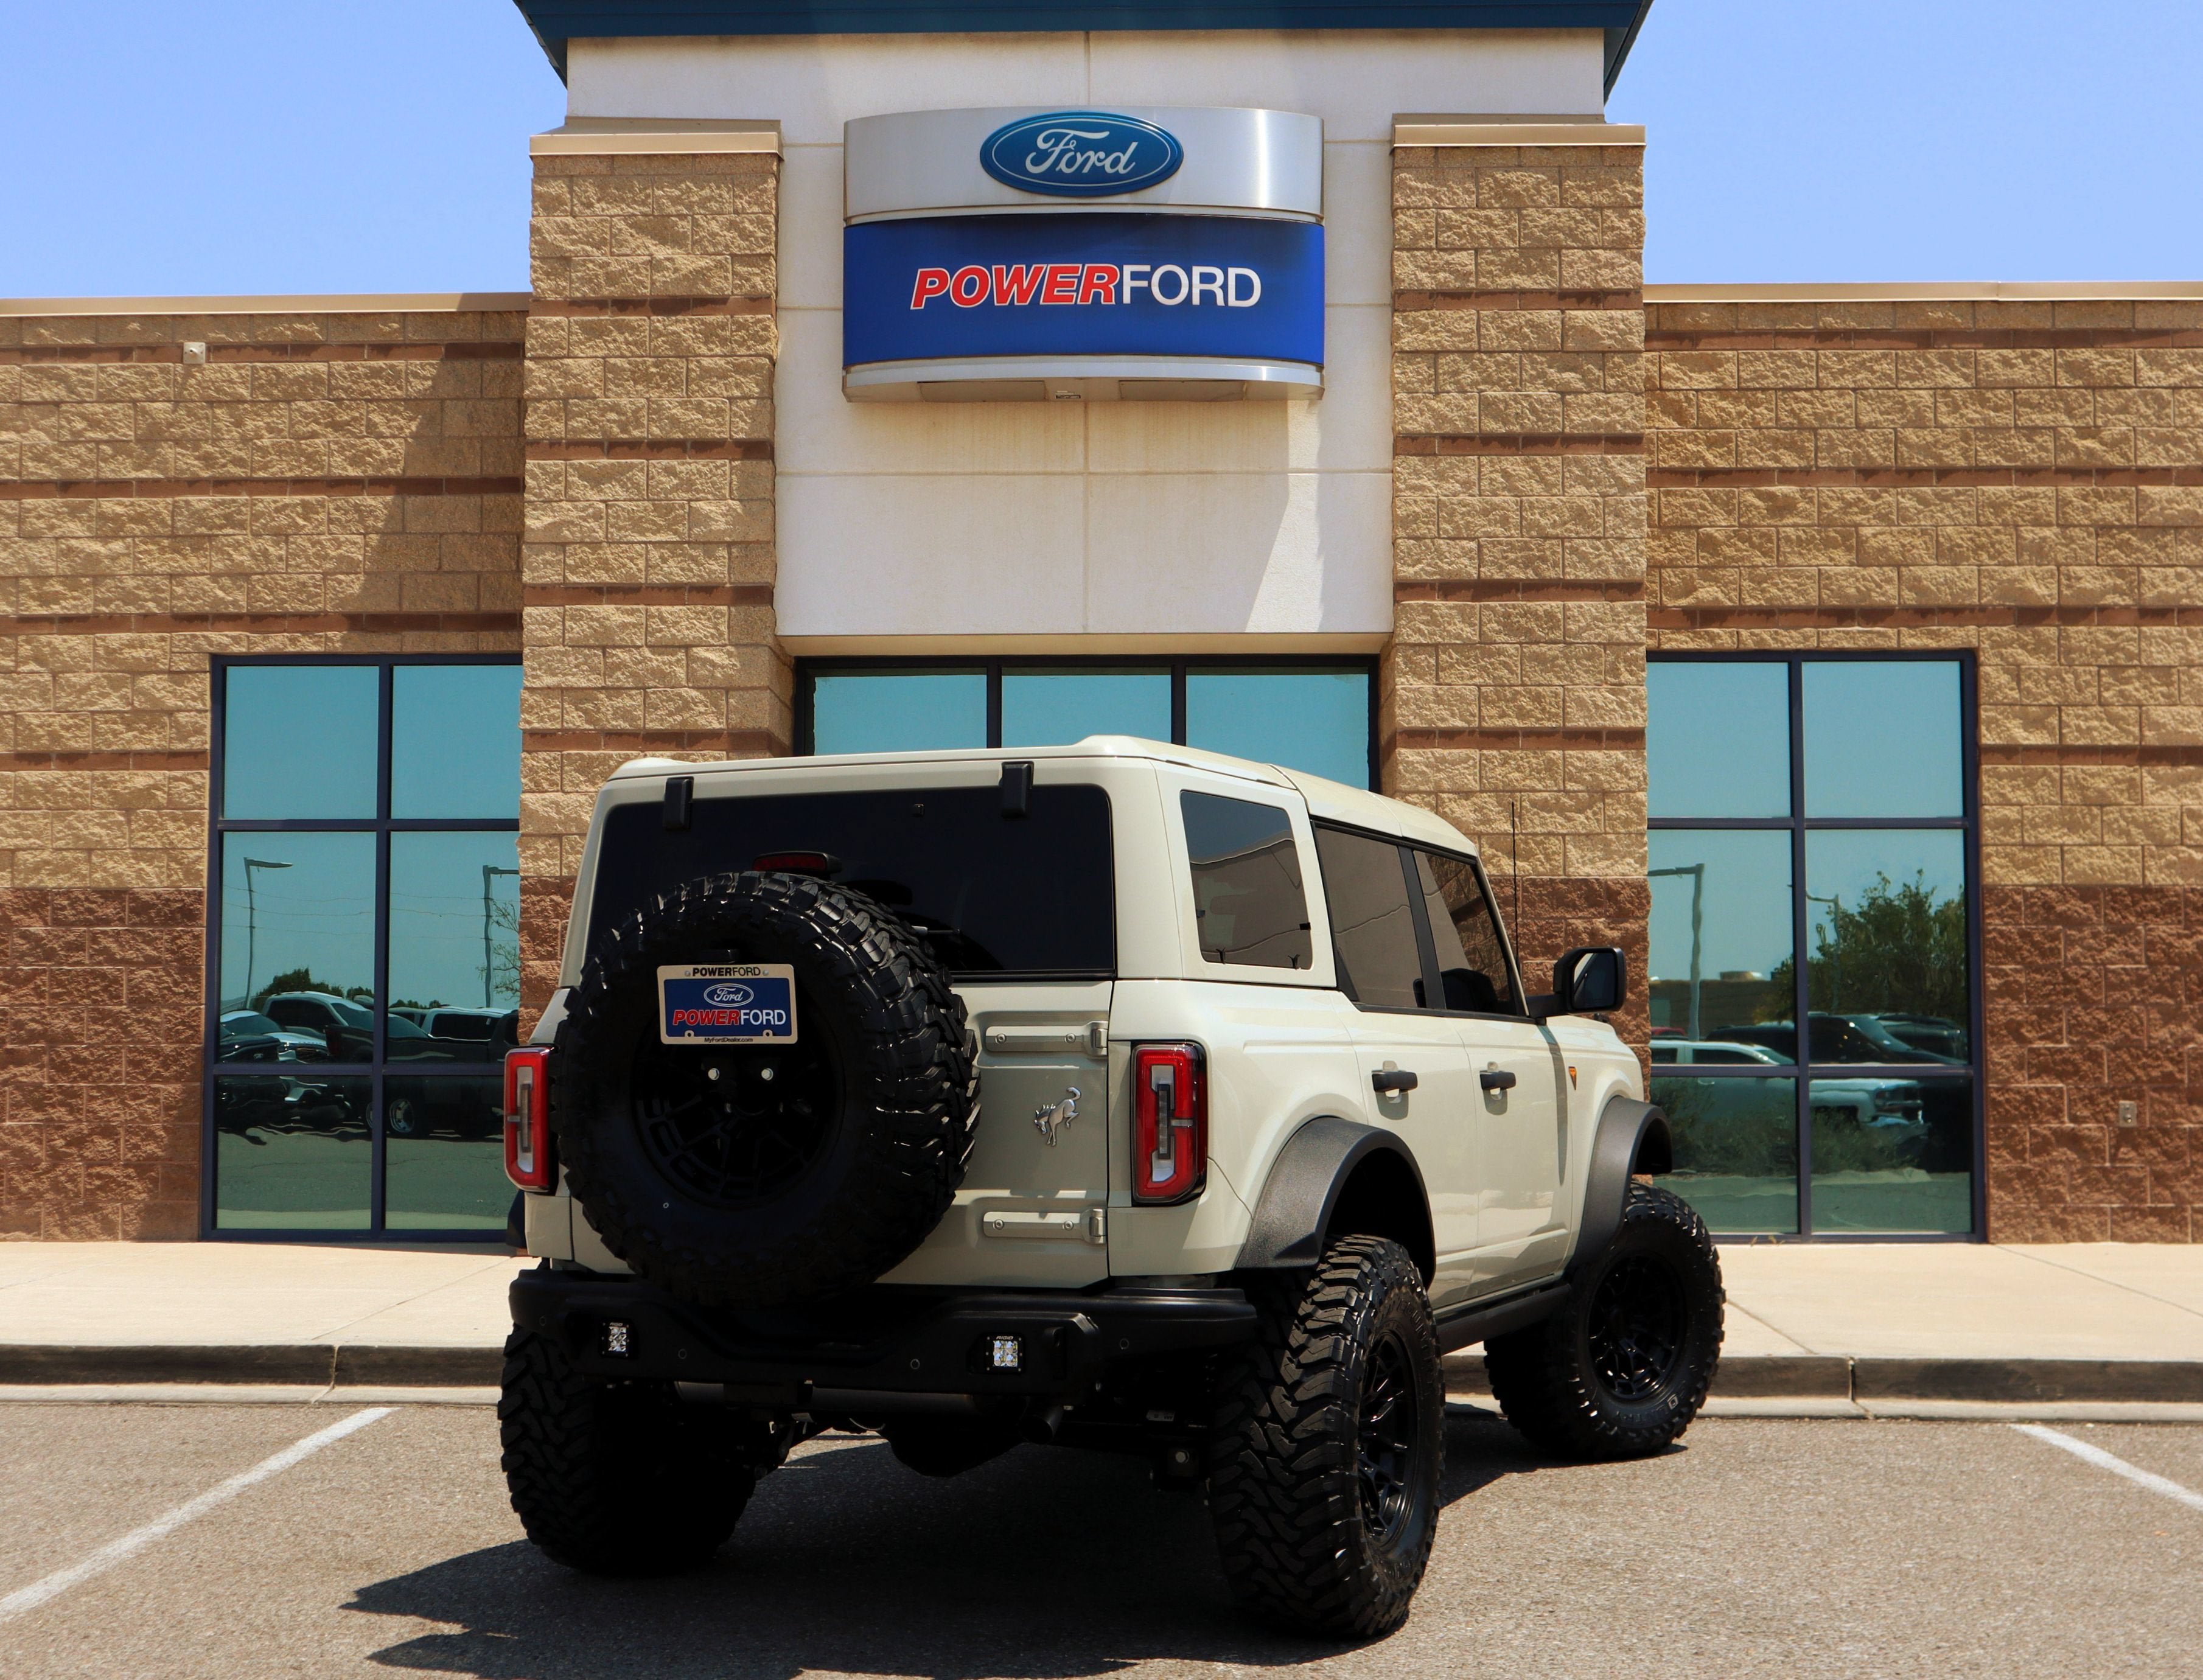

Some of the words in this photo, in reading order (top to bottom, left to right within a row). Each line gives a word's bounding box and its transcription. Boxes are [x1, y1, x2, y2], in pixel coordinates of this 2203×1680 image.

[1025, 128, 1139, 175] Ford
[910, 263, 1262, 310] POWERFORD
[693, 967, 761, 977] POWERFORD
[714, 987, 744, 1002] Ford
[672, 1009, 786, 1026] POWERFORD
